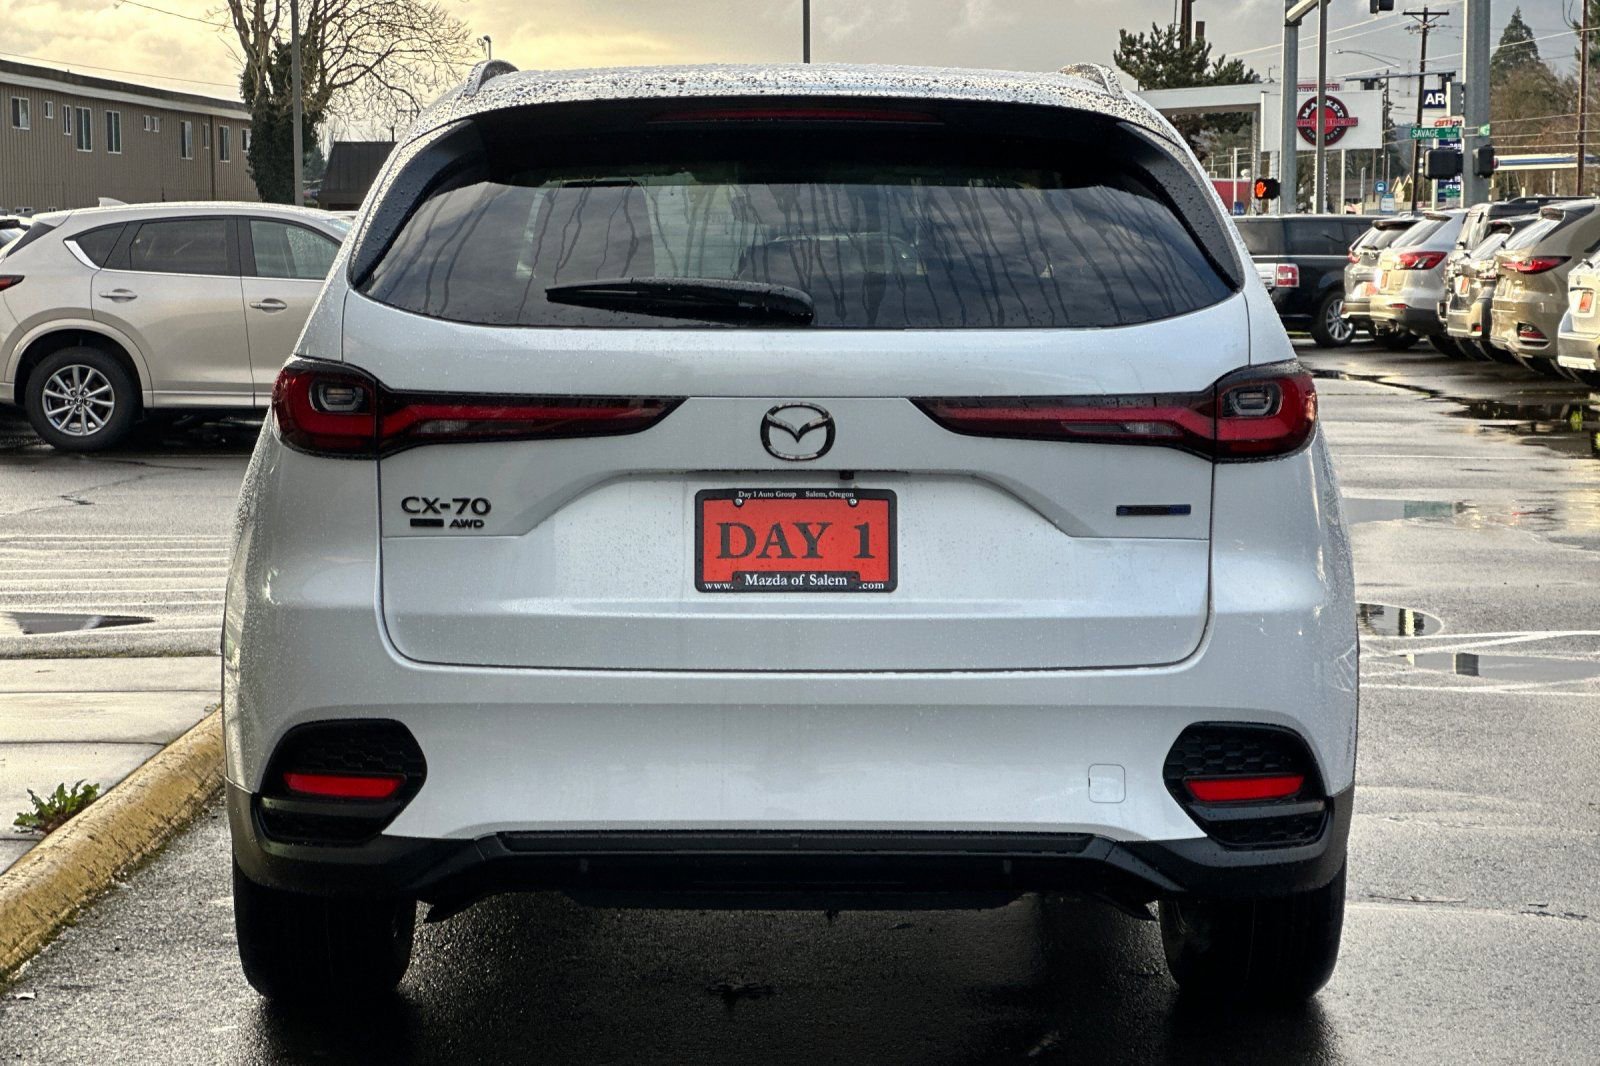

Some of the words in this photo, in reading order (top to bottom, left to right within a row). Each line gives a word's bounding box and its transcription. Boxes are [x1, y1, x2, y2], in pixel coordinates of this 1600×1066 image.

[1424, 93, 1447, 105] AR
[1302, 99, 1345, 119] MAKET
[1412, 128, 1440, 138] SAVAGE
[738, 490, 752, 499] Day
[753, 490, 757, 498] 1
[758, 490, 775, 498] Auto
[775, 490, 797, 499] Group
[805, 490, 828, 499] Salem,
[829, 490, 855, 499] Oregon
[401, 496, 492, 516] CX-70
[449, 518, 485, 529] AWD
[716, 521, 833, 559] DAY
[853, 521, 876, 559] 1
[704, 582, 734, 590] www.
[745, 573, 787, 586] Mazda
[791, 573, 805, 586] of
[809, 573, 848, 586] Salem
[858, 581, 885, 590] .com
